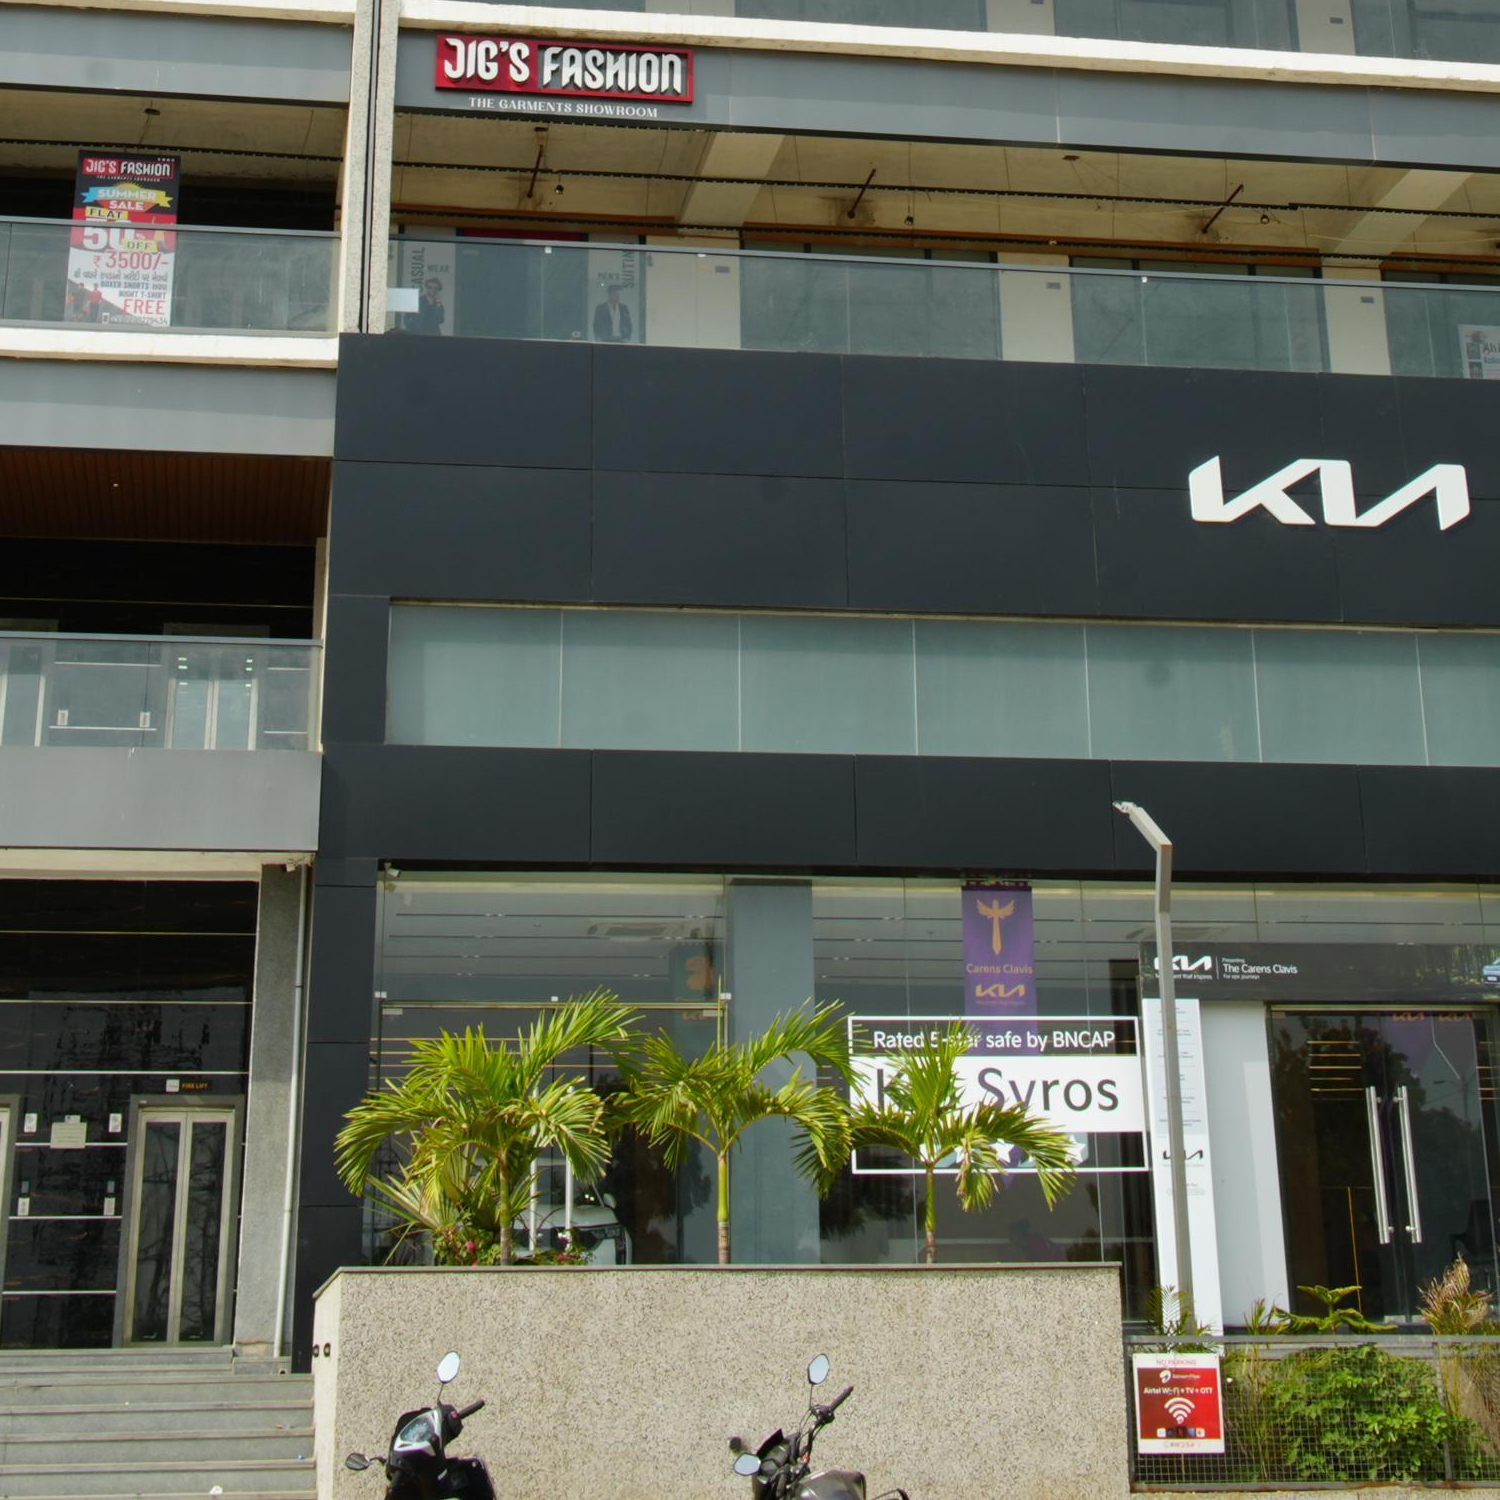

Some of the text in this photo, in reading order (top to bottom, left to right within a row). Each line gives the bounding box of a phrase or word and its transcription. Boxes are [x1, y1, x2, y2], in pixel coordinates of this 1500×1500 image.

[443, 37, 684, 95] JIG'S FASHION
[468, 97, 658, 118] THE GARMENTS SHOWROOM
[86, 159, 171, 177] JIG'S FASHION
[97, 188, 157, 200] SUMMER
[108, 200, 145, 211] SALE
[89, 208, 123, 219] FLAT
[126, 241, 151, 250] OFF
[106, 251, 169, 270] 3500/-
[427, 264, 450, 273] WEAR
[123, 298, 165, 315] FREE
[1188, 455, 1471, 531] KIA
[965, 963, 1034, 974] Carens Clavis
[1222, 963, 1299, 974] The Carens Clavis
[975, 983, 1026, 997] KIA
[873, 1030, 925, 1048] Rated
[986, 1030, 1023, 1048] safe
[1026, 1030, 1048, 1052] by
[1052, 1030, 1115, 1048] BNCAP
[977, 1067, 1120, 1112] Syros
[1143, 1387, 1162, 1395] Airtel
